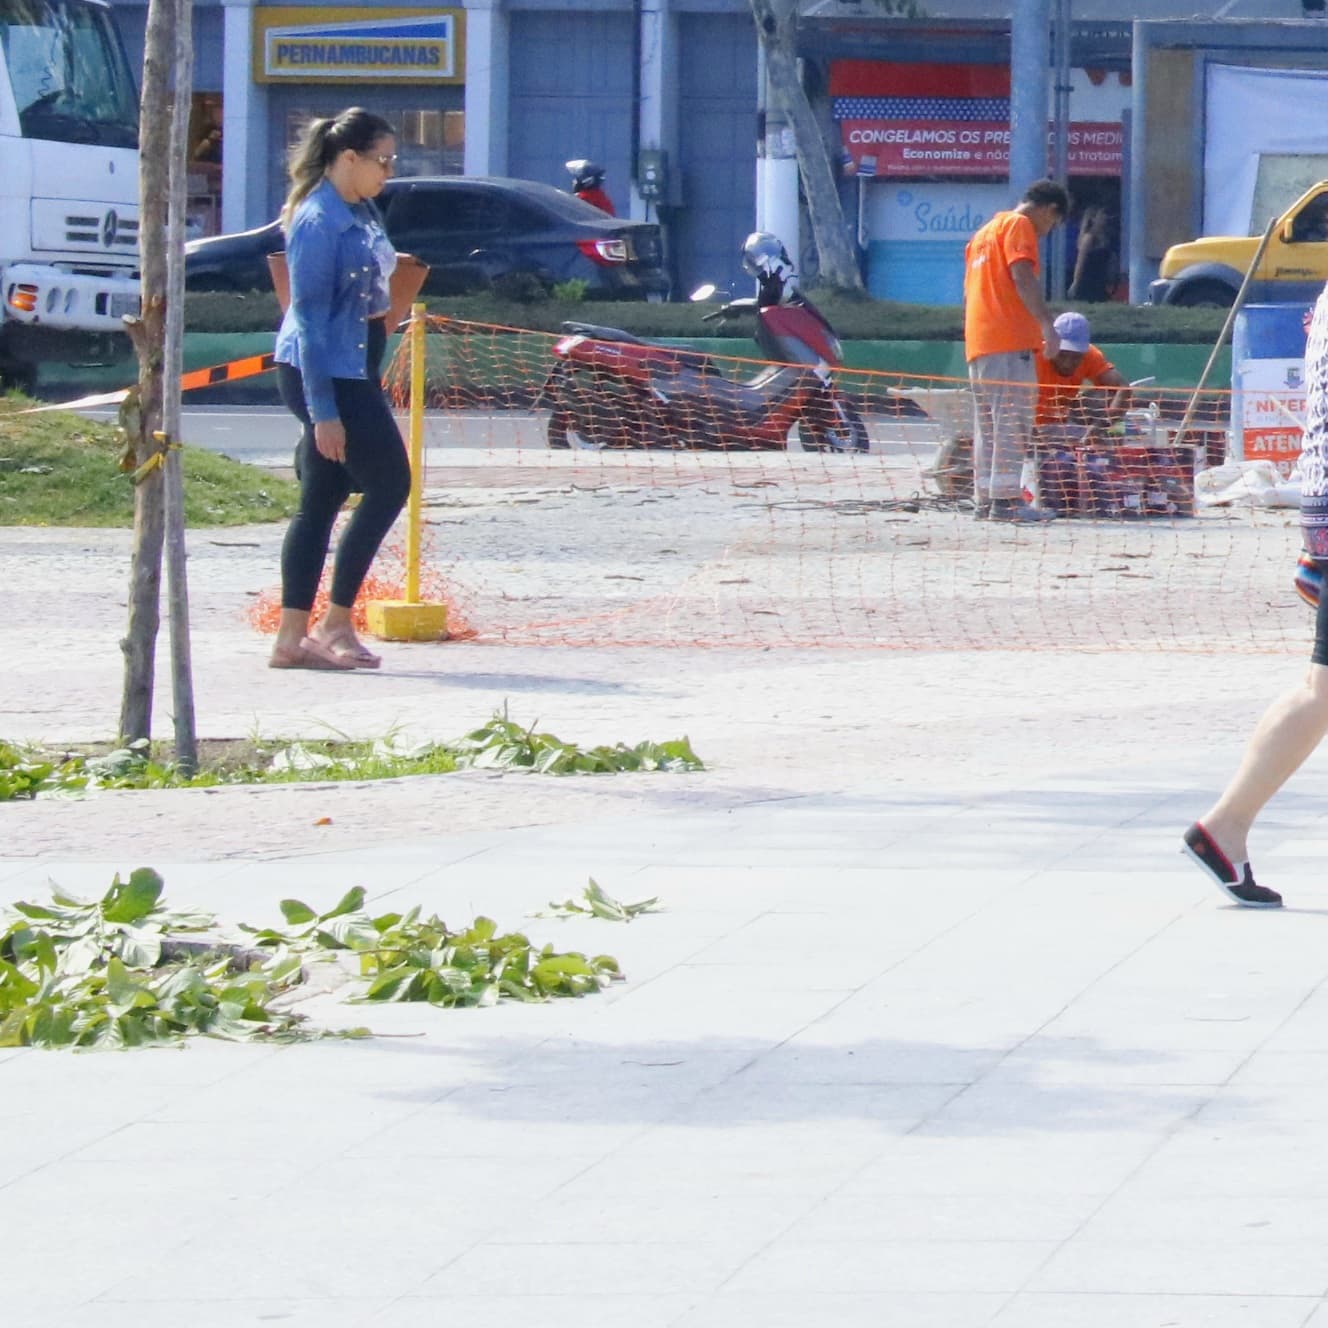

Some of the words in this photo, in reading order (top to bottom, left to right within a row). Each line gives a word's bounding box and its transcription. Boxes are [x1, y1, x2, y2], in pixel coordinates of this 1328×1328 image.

[276, 43, 441, 66] PERNAMBUCANAS
[850, 129, 956, 145] CONGELAMOS
[959, 130, 981, 145] OS
[903, 148, 971, 160] Economize
[974, 150, 983, 160] e
[914, 202, 984, 233] Saúde
